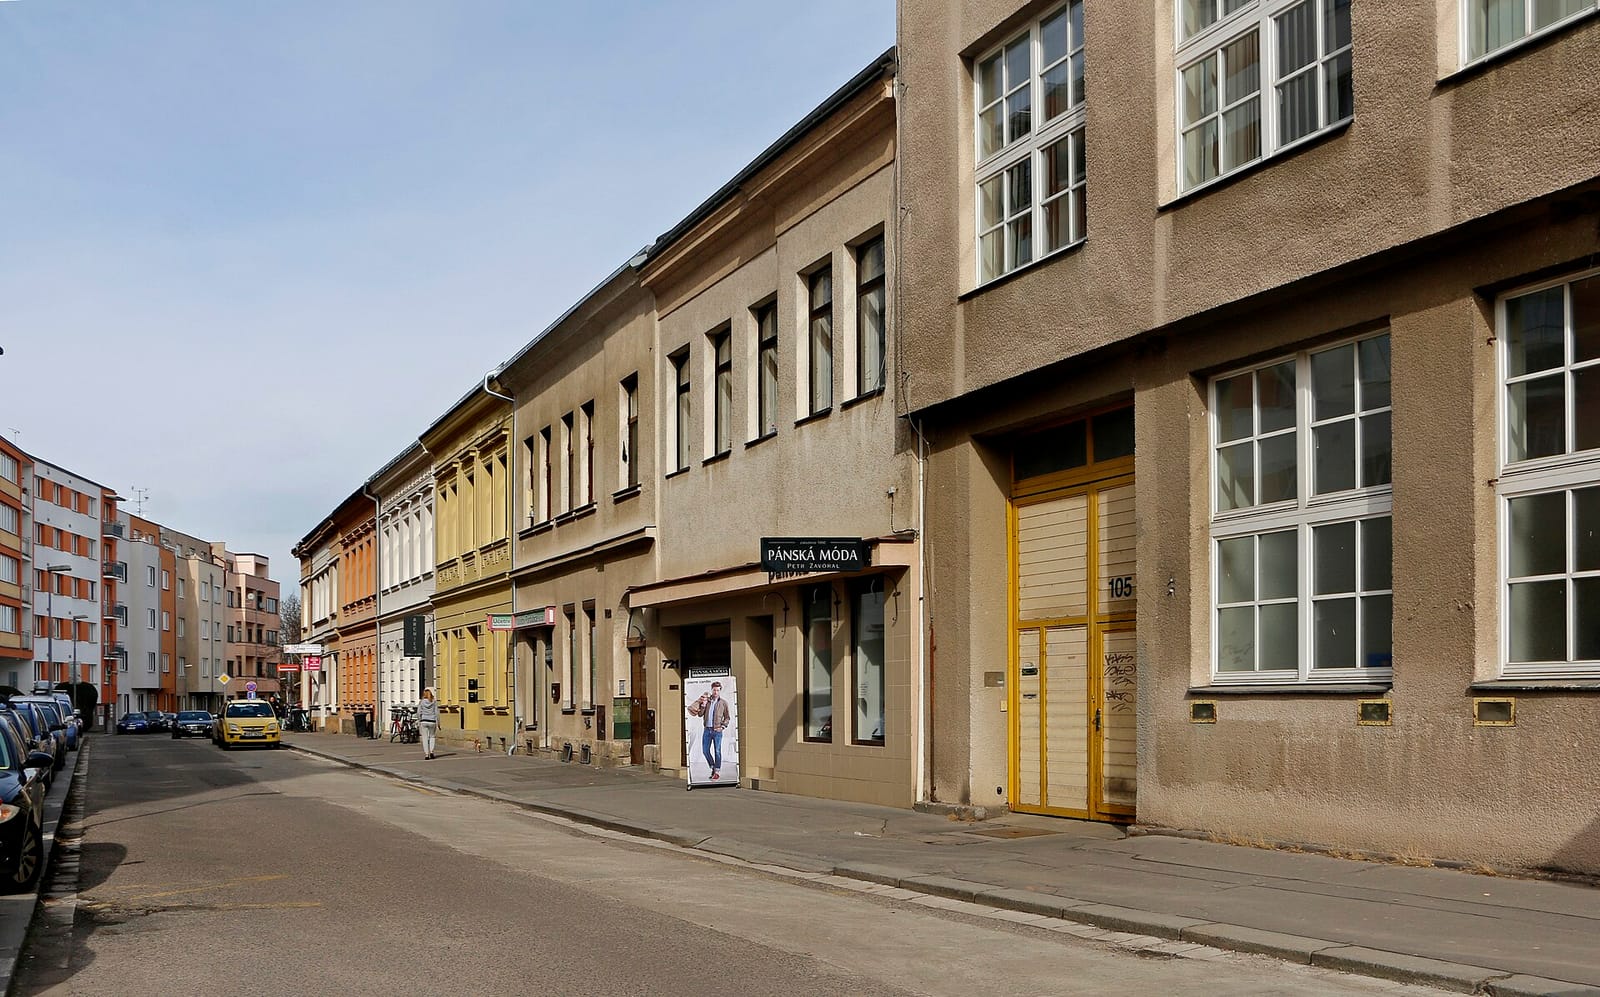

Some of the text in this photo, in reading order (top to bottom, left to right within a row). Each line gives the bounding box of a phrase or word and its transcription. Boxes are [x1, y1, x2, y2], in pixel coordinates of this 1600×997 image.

[768, 546, 858, 561] PÁNSKÁ MÓDA
[1109, 577, 1132, 598] 105
[662, 660, 679, 669] 721
